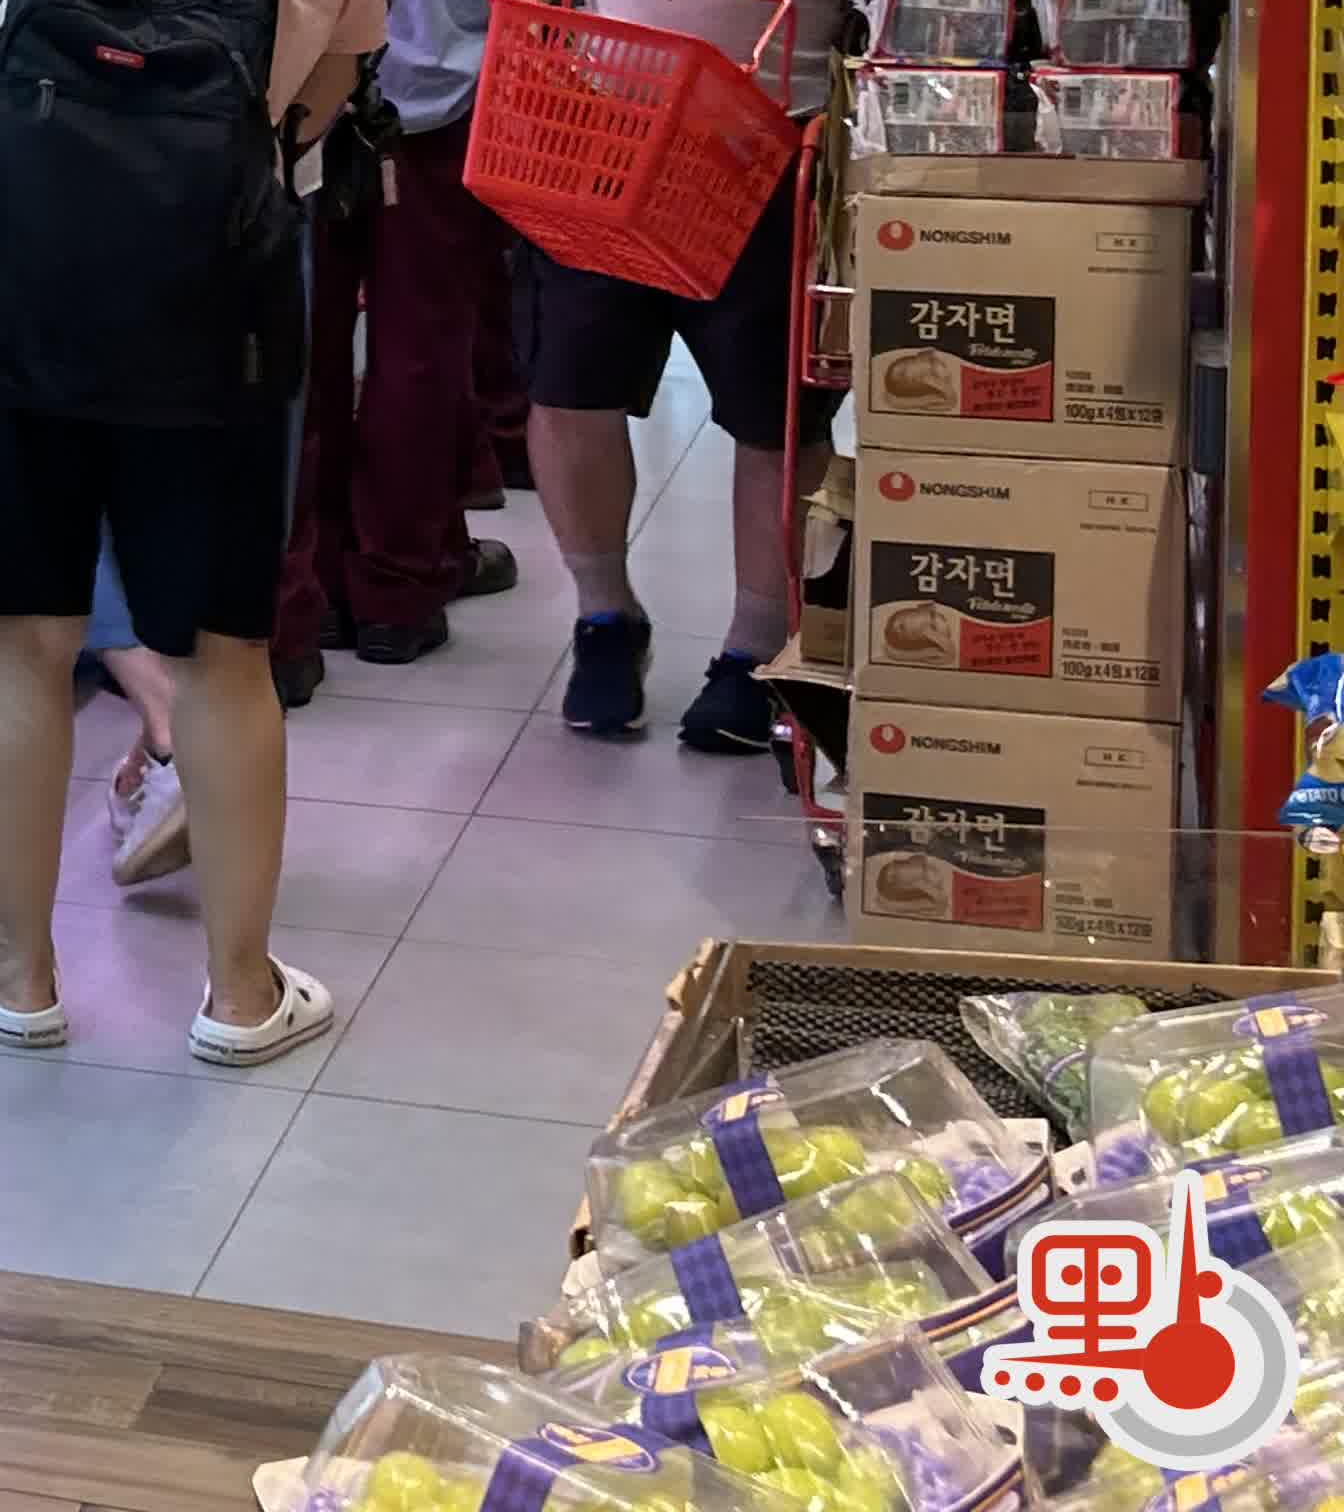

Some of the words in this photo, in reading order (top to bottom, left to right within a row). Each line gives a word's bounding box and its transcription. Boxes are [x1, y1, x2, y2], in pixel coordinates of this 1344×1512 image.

[919, 227, 1012, 246] NONGSHIM
[909, 299, 1016, 345] 감자면
[919, 481, 1011, 501] NONGSHIM
[909, 551, 1016, 599] 감자면
[910, 735, 1002, 756] NONGSHIM
[902, 804, 1006, 853] 감자면
